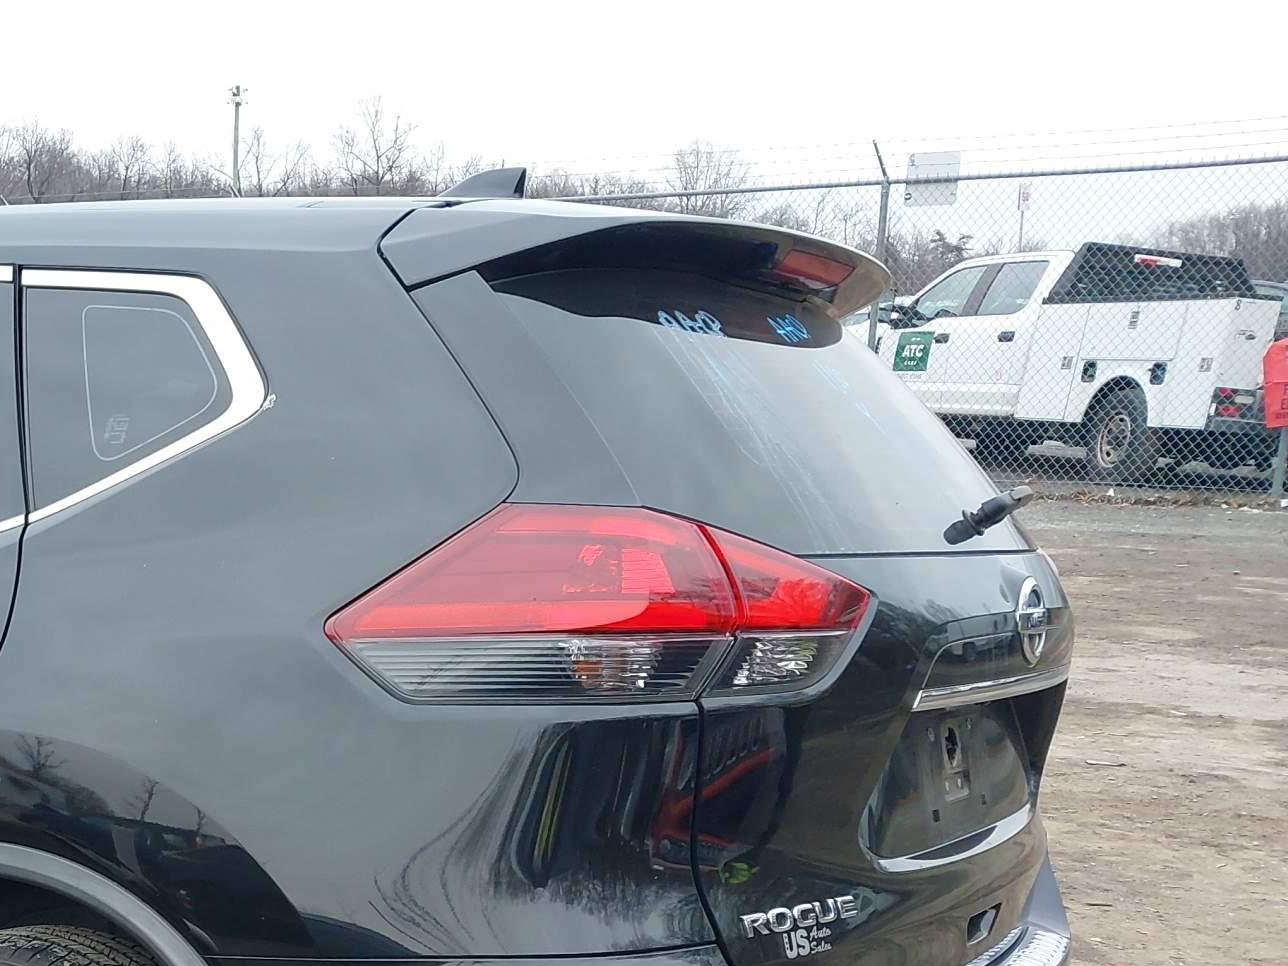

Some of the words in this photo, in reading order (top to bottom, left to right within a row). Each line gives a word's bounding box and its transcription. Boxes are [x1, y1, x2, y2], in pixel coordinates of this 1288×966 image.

[902, 344, 924, 357] ATC
[739, 895, 858, 938] ROGUE
[783, 929, 811, 959] US
[810, 926, 832, 941] Auto
[811, 941, 832, 954] Sales
